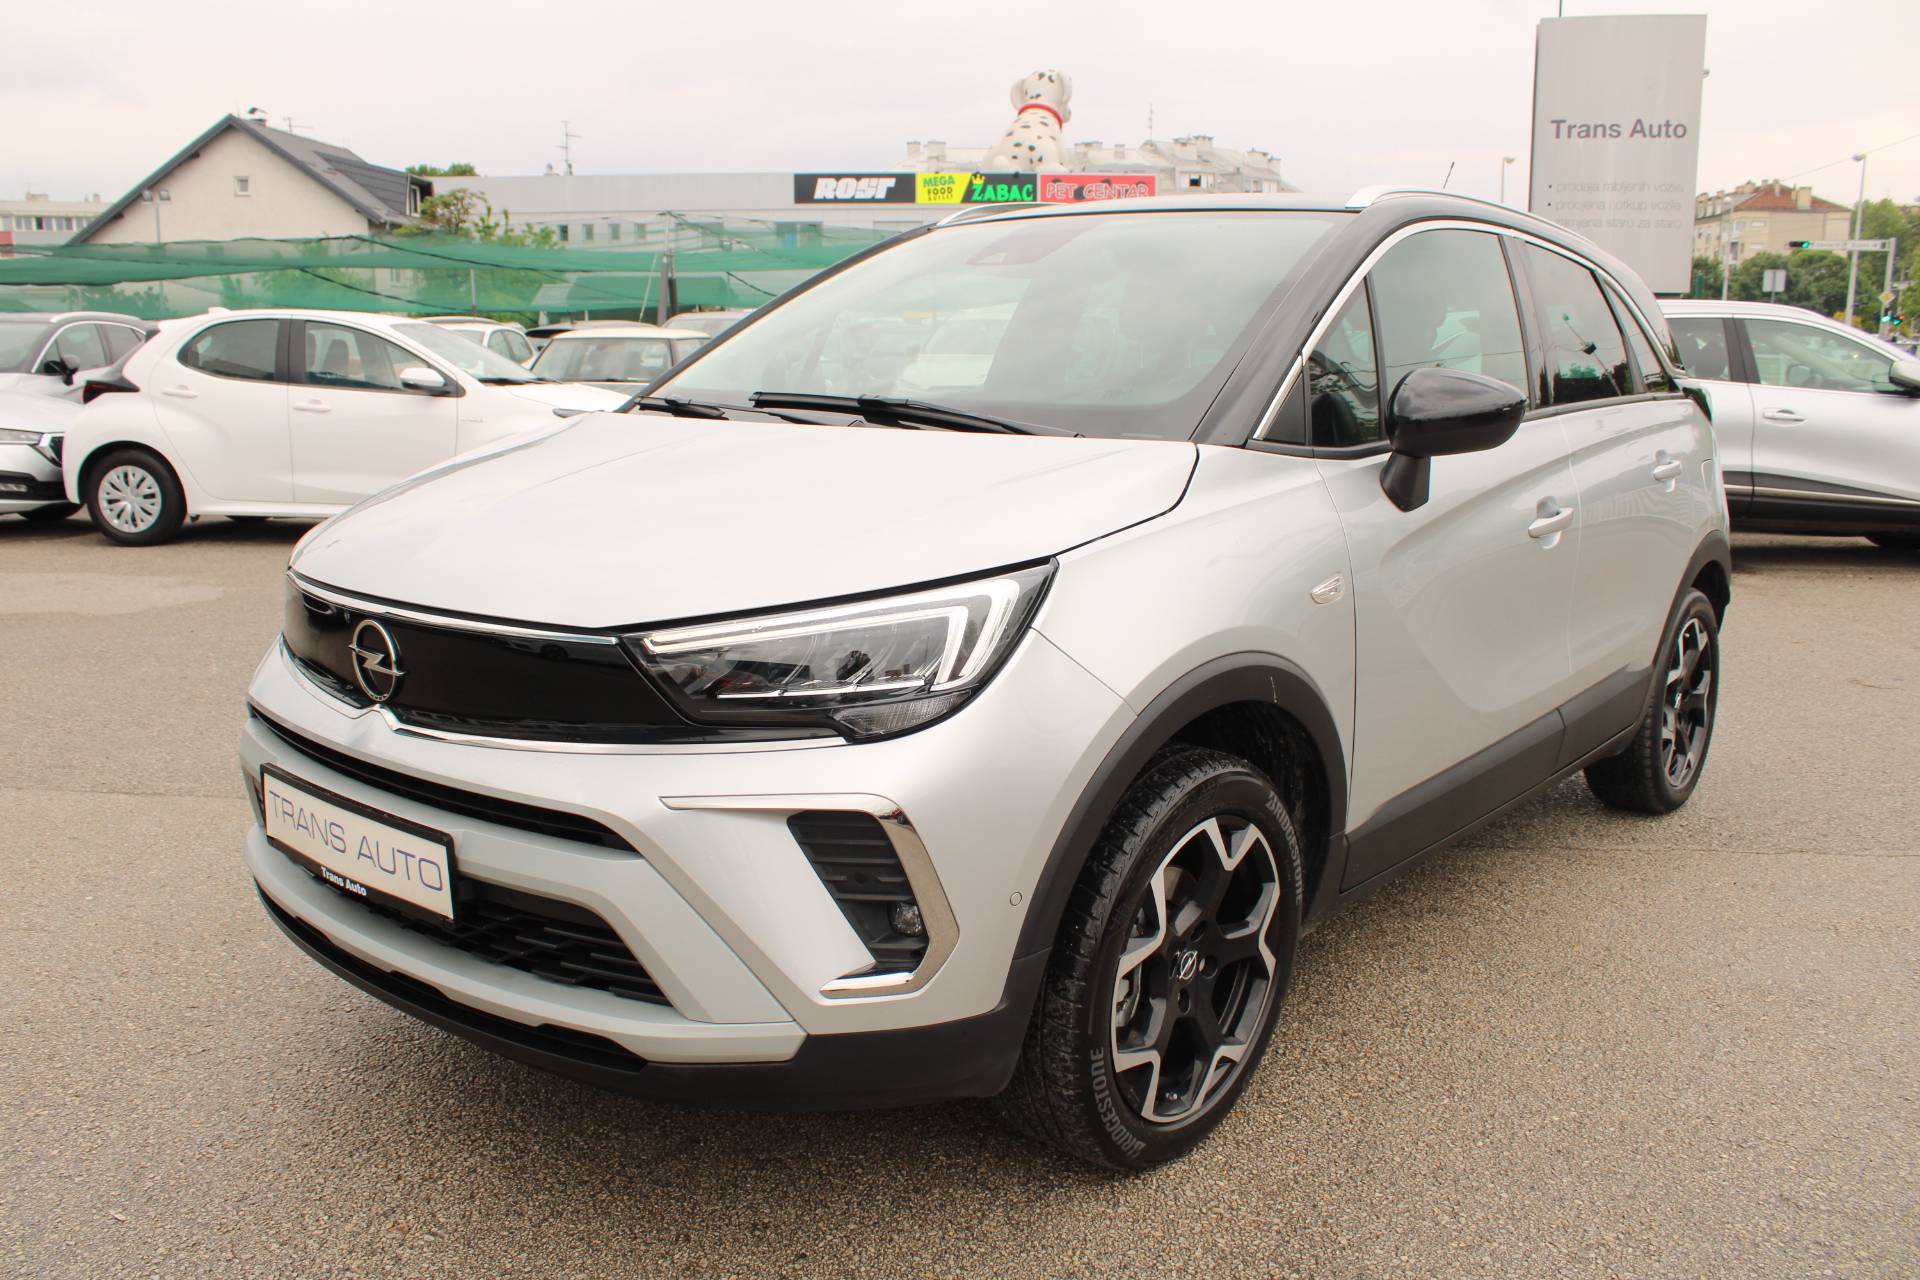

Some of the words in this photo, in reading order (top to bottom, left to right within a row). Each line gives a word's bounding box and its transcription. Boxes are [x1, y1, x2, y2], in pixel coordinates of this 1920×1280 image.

[1550, 119, 1621, 140] Trans
[1629, 118, 1688, 139] Auto
[813, 177, 896, 200] ROST
[923, 175, 955, 188] MEGA
[927, 186, 953, 196] FOOD
[1046, 182, 1077, 199] PET
[1083, 182, 1149, 199] CENTAR
[269, 790, 347, 854] TRANS
[357, 835, 443, 892] AUTO
[321, 866, 344, 887] Trans
[345, 880, 367, 897] Auto
[1091, 1048, 1146, 1159] BRIDGESTONE
